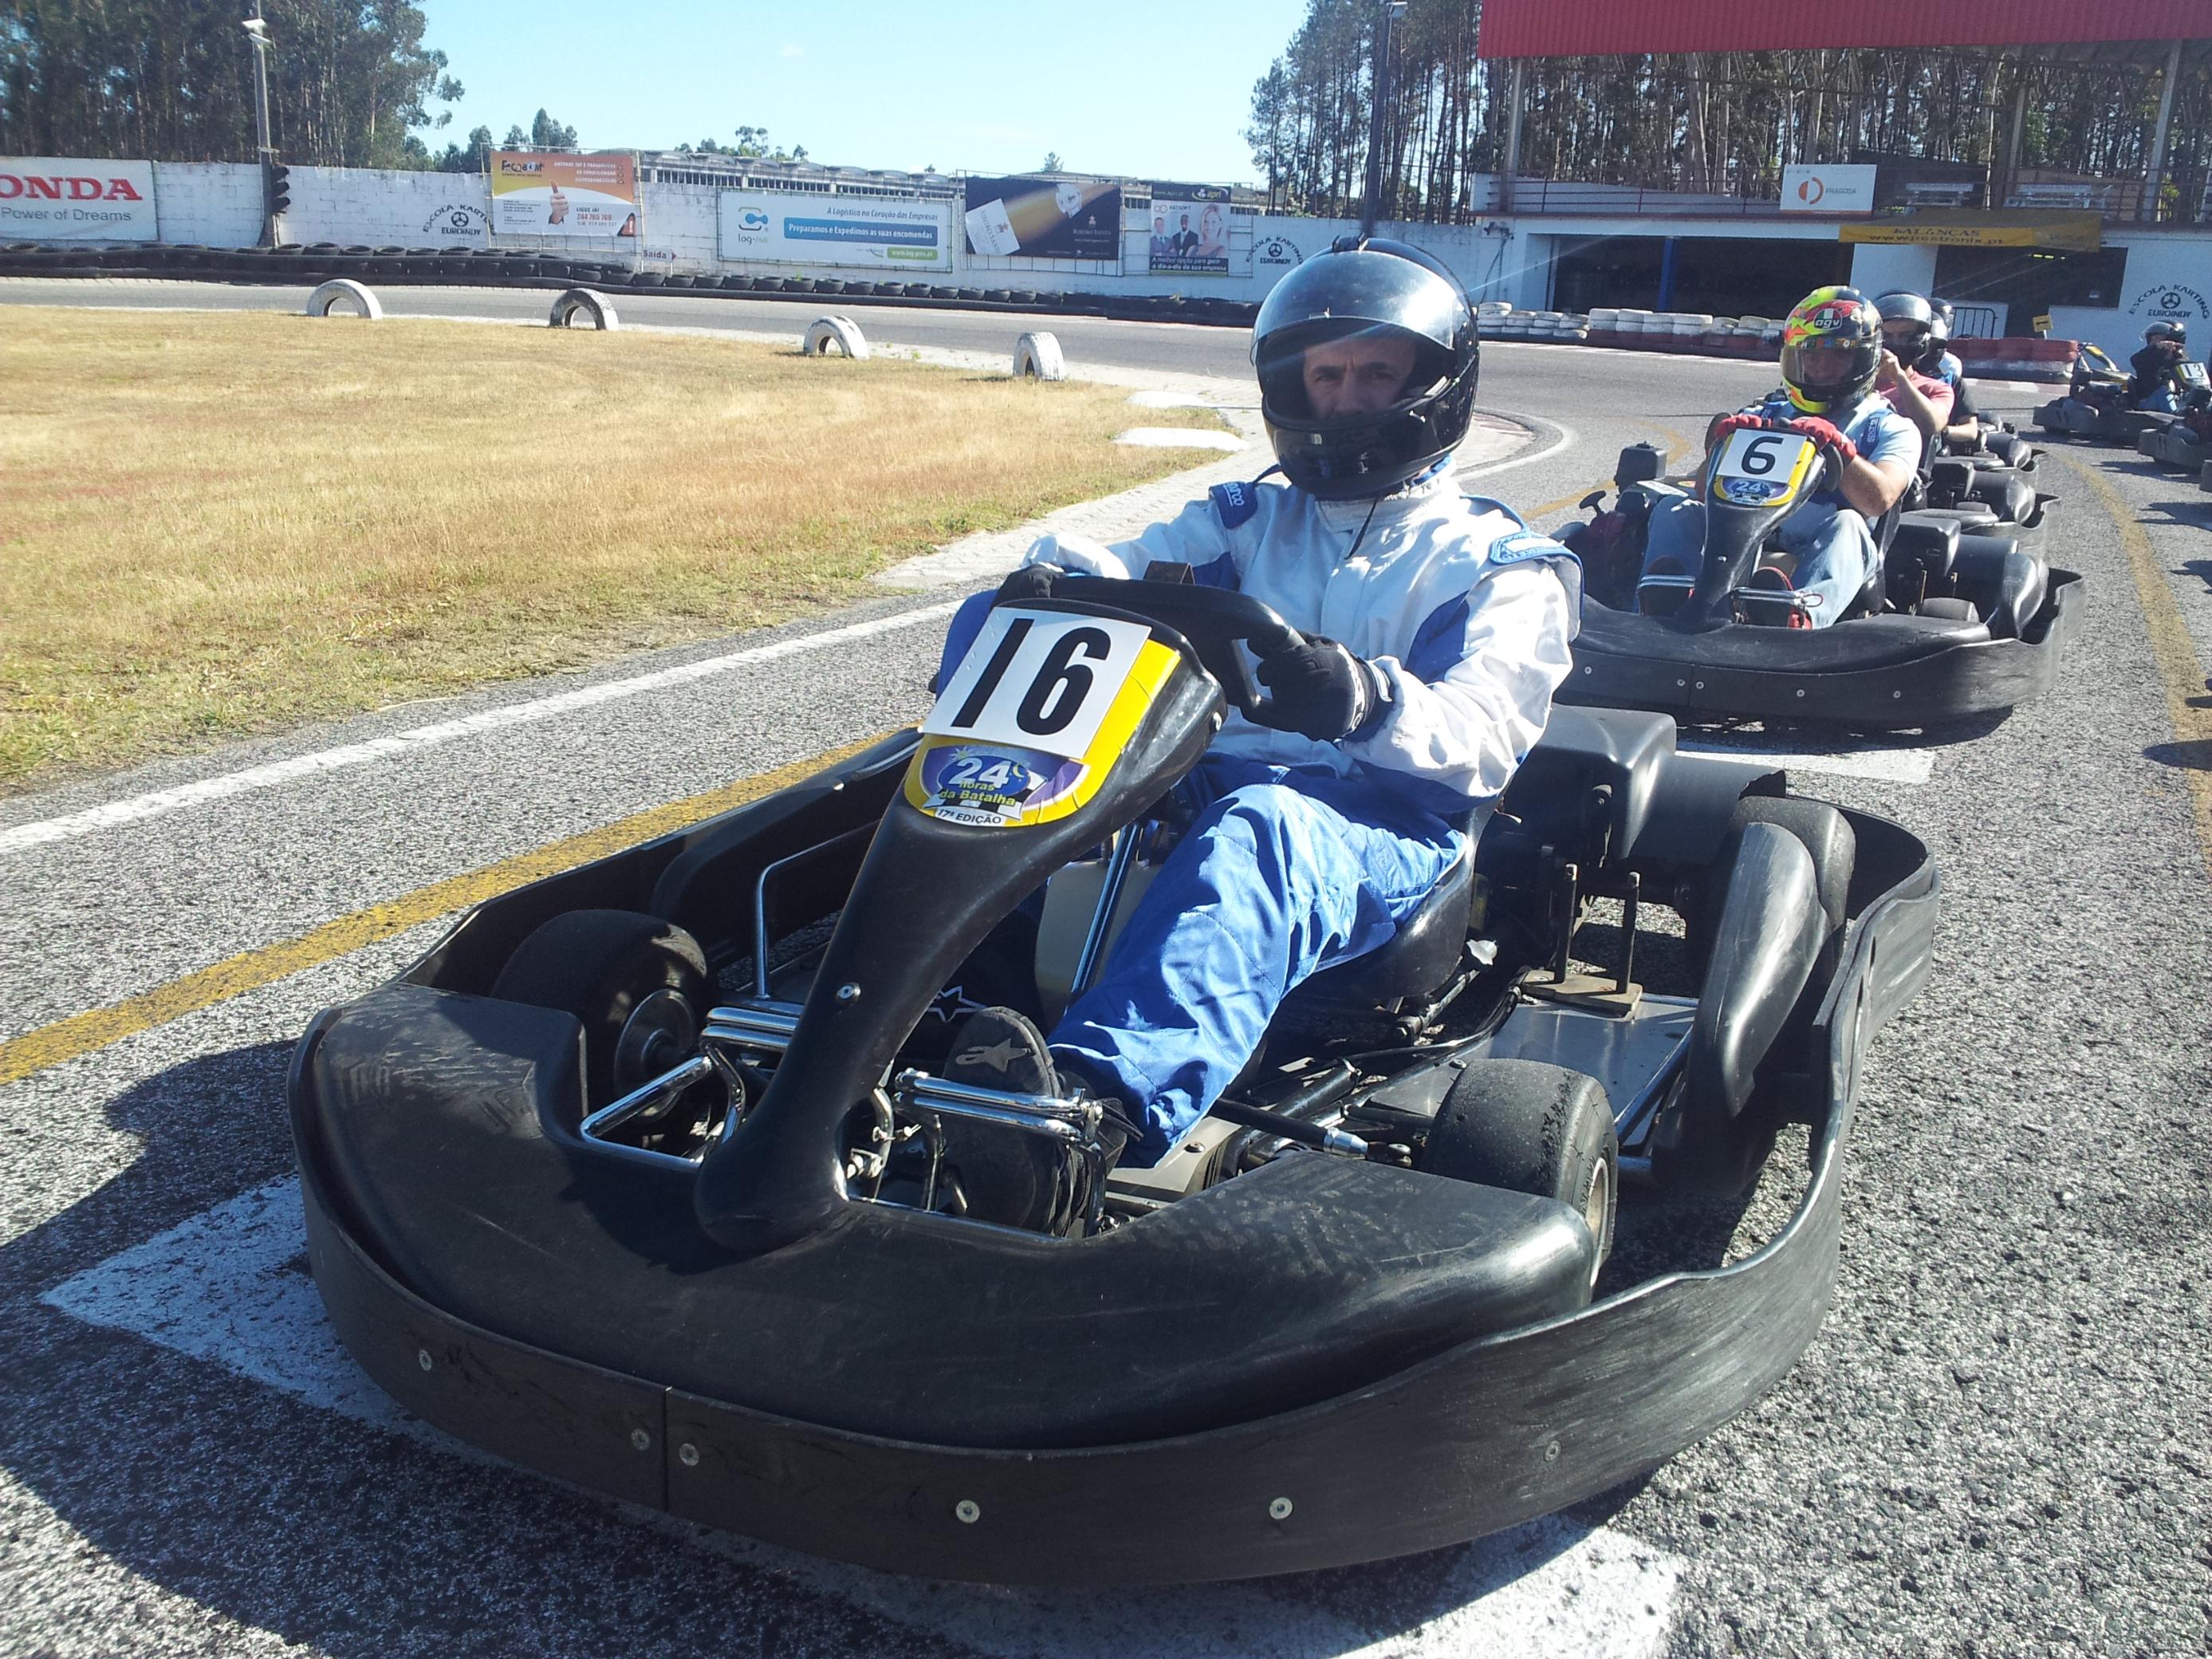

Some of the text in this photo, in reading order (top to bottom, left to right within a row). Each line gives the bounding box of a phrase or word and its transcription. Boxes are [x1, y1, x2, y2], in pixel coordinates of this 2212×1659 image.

[0, 174, 142, 200] ONDA
[2, 207, 132, 221] Power of Dreams
[909, 211, 938, 221] Empresas
[441, 227, 482, 236] EUROINDY
[789, 223, 828, 234] Preparamos
[834, 226, 869, 235] Expedimos
[893, 230, 933, 239] encomendas
[2128, 284, 2210, 319] ESCOLA KARTING
[2147, 309, 2192, 317] EUROINDY
[1815, 319, 1840, 329] agv
[2184, 364, 2204, 377] 13
[1741, 435, 1784, 475] 6
[1736, 480, 1761, 493] 24
[951, 617, 1112, 735] 16
[948, 757, 1012, 788] 24
[939, 789, 1016, 808] da Batalha
[956, 812, 1002, 825] EDIÇÃO
